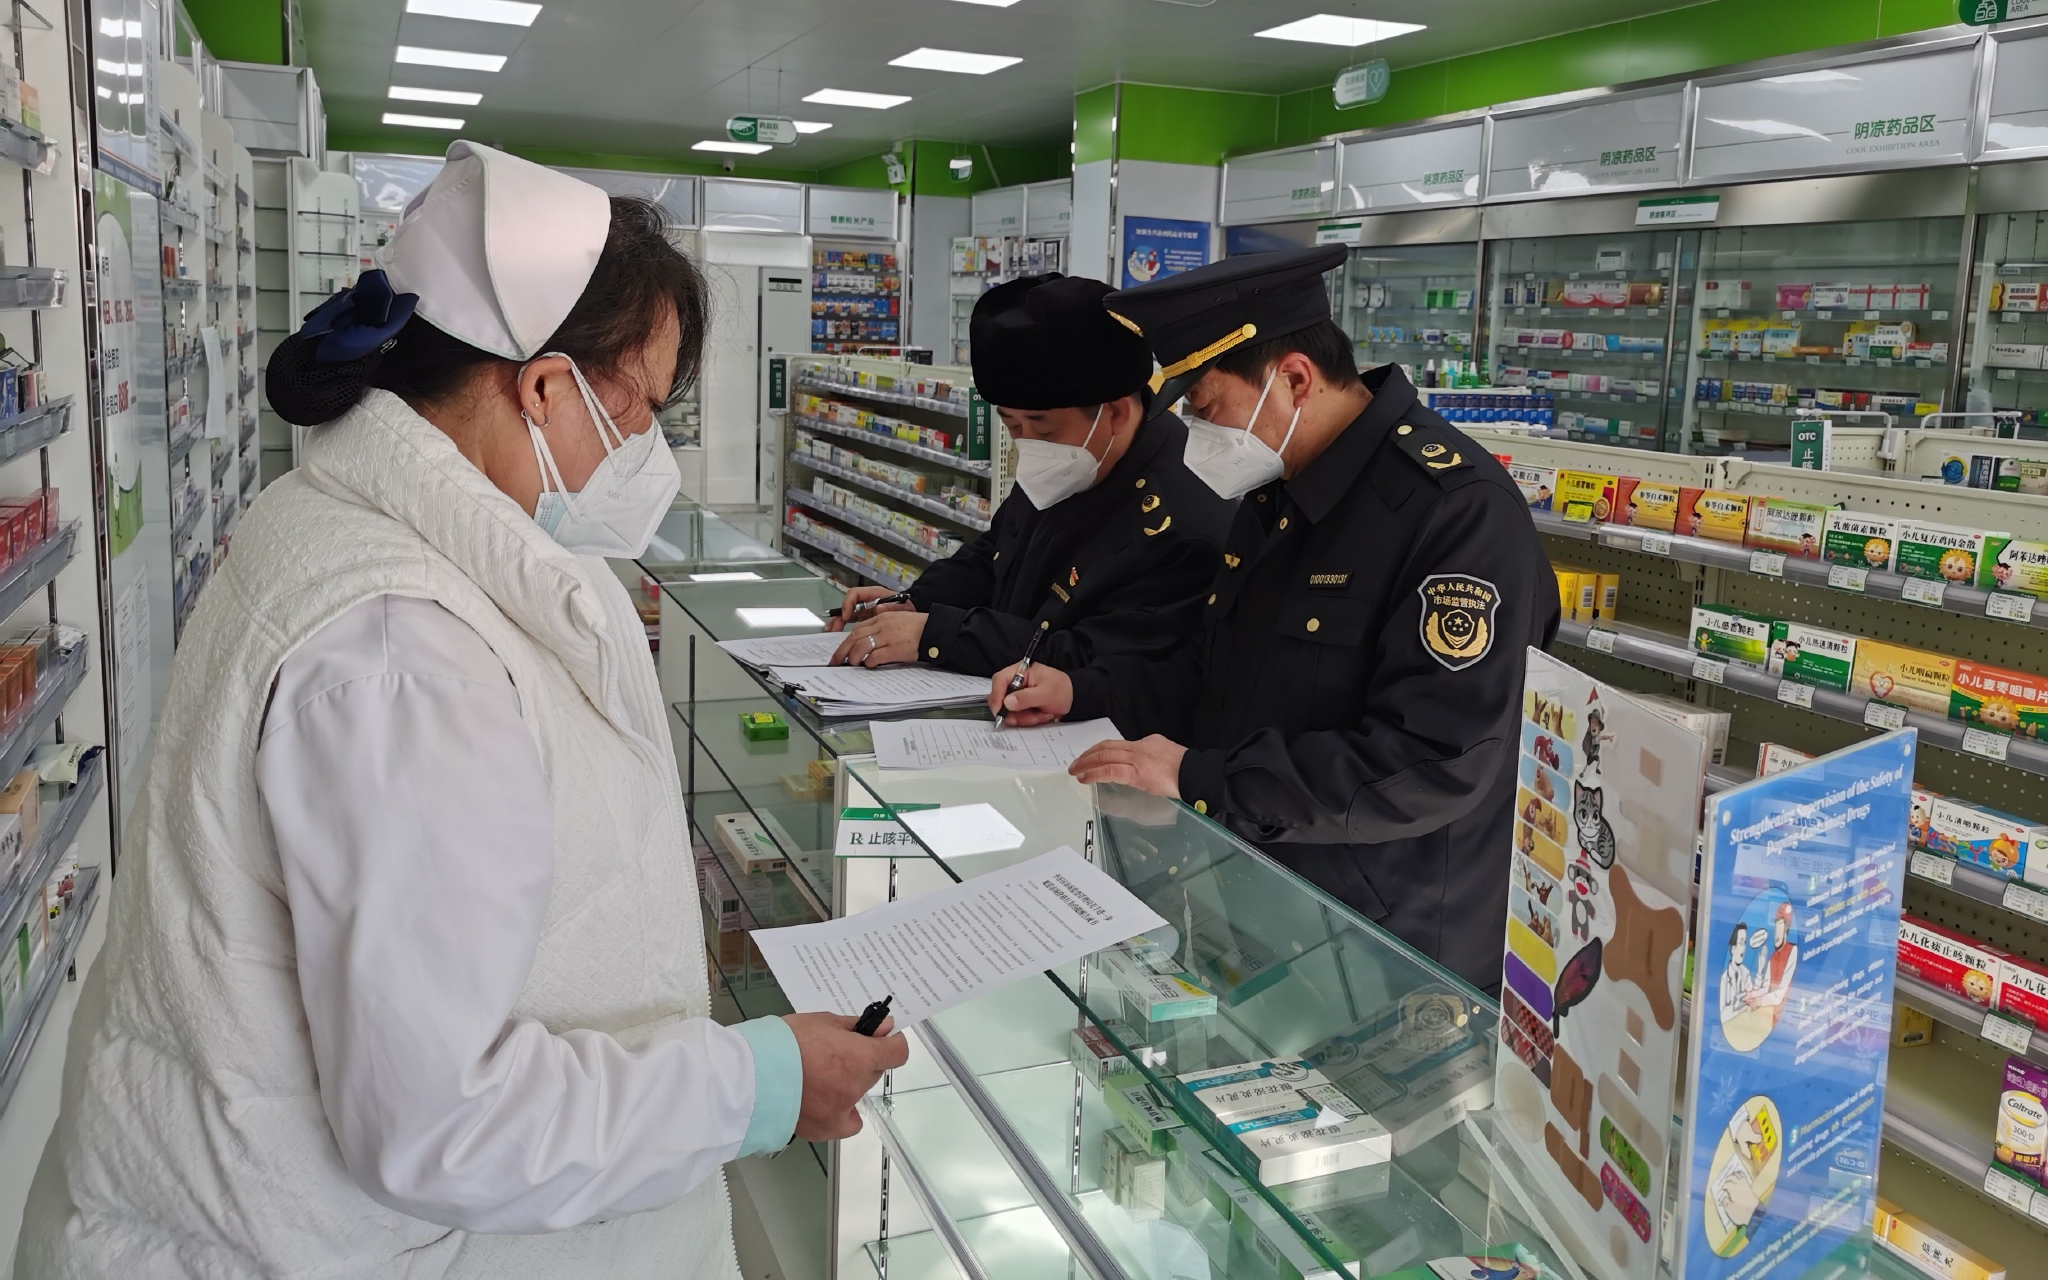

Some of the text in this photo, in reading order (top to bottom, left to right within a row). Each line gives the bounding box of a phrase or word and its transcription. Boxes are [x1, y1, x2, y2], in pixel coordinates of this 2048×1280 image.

[1854, 114, 1936, 140] 阴凉药品区
[1600, 146, 1657, 166] 阴凉药品区
[1846, 139, 1940, 155] COOL EXHIBITION AREA
[1423, 169, 1464, 186] 阴凉药品区
[830, 215, 875, 226] 健康相关产品
[976, 406, 985, 445] 肠胃用药
[1798, 432, 1816, 441] OTC
[1566, 479, 1596, 491] 小儿感冒颗粒
[1640, 491, 1675, 503] 参苓白术颗粒
[1704, 500, 1745, 513] 参苓白术颗粒
[1767, 507, 1816, 523] 阿苯达唑颗粒
[1833, 521, 1887, 537] 乳酸菌素颗粒
[1902, 530, 1977, 550] 小儿复方鸡内金散
[1427, 582, 1492, 603] 中华人民共和国
[1433, 595, 1486, 611] 市场监管执法
[1798, 635, 1849, 654] 小儿热速清颗粒
[1900, 662, 1951, 683] 小儿咽扁颗粒
[1957, 672, 2048, 704] 小儿麦枣咀嚼片
[1730, 806, 1795, 845] Strengthening
[1796, 789, 1846, 818] Supervision
[1846, 783, 1856, 798] of
[1856, 779, 1869, 795] the
[1870, 766, 1893, 790] Safety
[1894, 763, 1904, 780] of
[1847, 803, 1871, 823] Drugs
[1936, 811, 1990, 834] 小儿清咽颗粒
[1899, 927, 1987, 971] 小儿化痰止咳颗粒
[2011, 973, 2046, 996] 小儿化
[1216, 1082, 1293, 1104] 银花泌炎灵片
[2007, 1098, 2043, 1120] Caltrate
